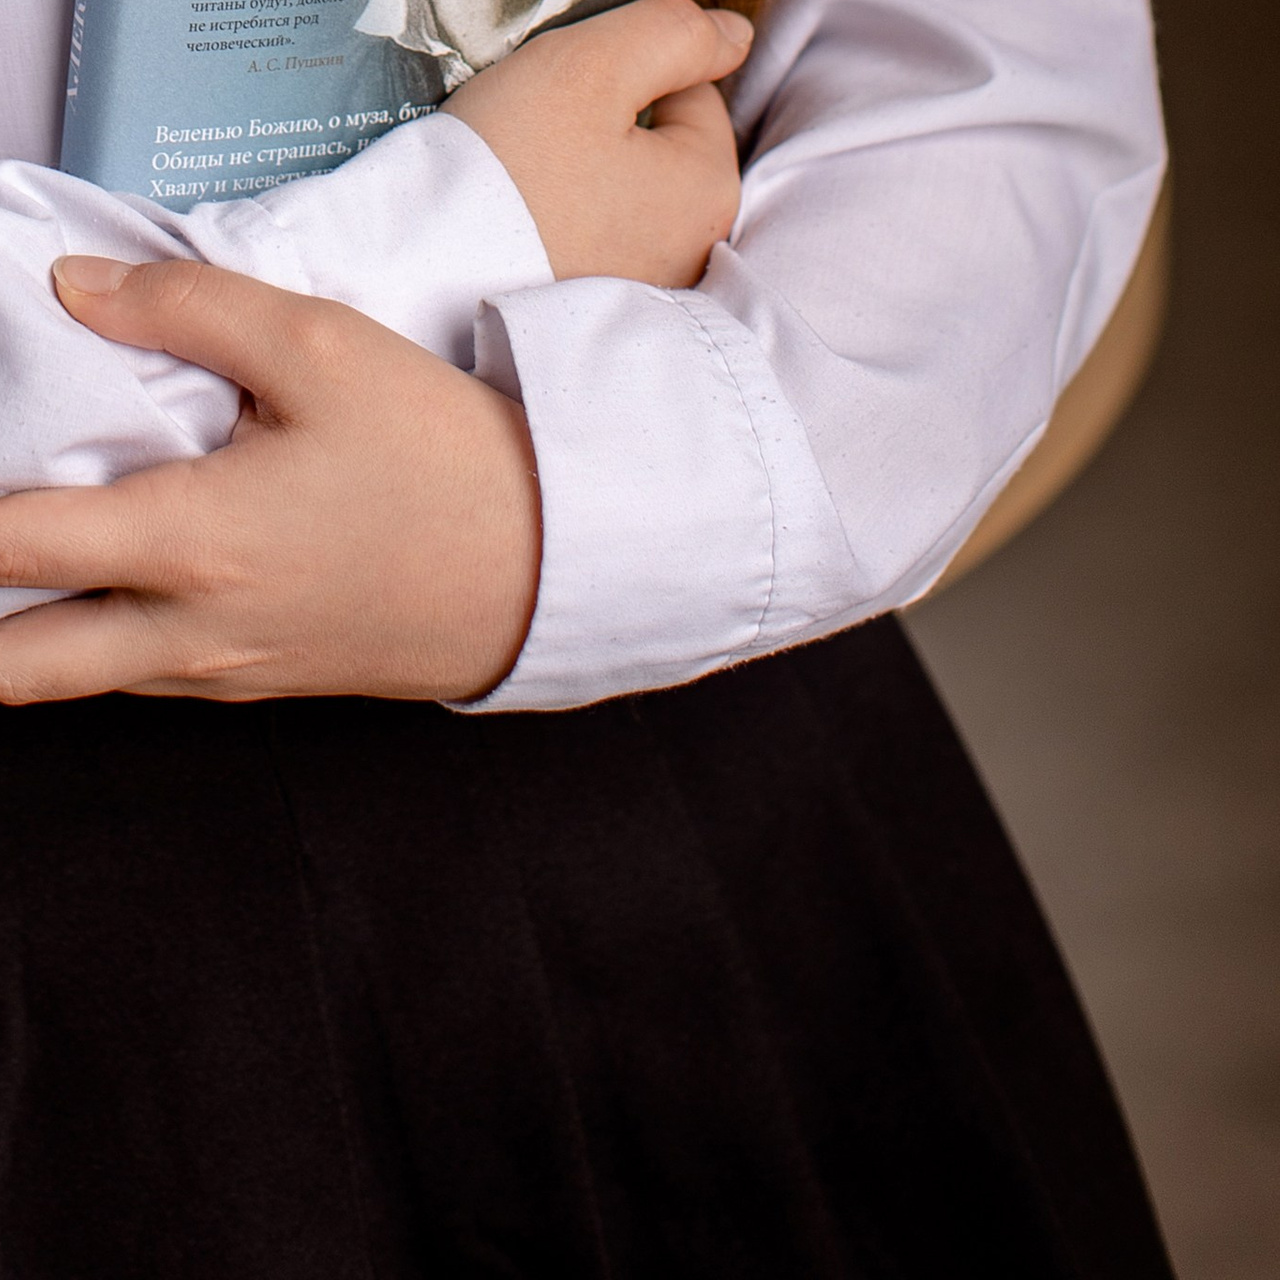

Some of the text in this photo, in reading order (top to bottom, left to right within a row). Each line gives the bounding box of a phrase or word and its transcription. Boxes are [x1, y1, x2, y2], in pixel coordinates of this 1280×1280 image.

[191, 0, 246, 13] читаны
[189, 13, 320, 34] не истребится род
[186, 35, 296, 53] человеческий».
[247, 53, 345, 74] А. С. Пушкин
[155, 124, 243, 145] Веленью
[249, 117, 324, 137] Божию,
[328, 115, 341, 129] о
[345, 108, 394, 131] муза,
[151, 151, 223, 172] Обиды
[229, 151, 253, 166] не
[256, 140, 352, 167] страшась,
[149, 179, 209, 200] Хвалу
[214, 180, 227, 194] и
